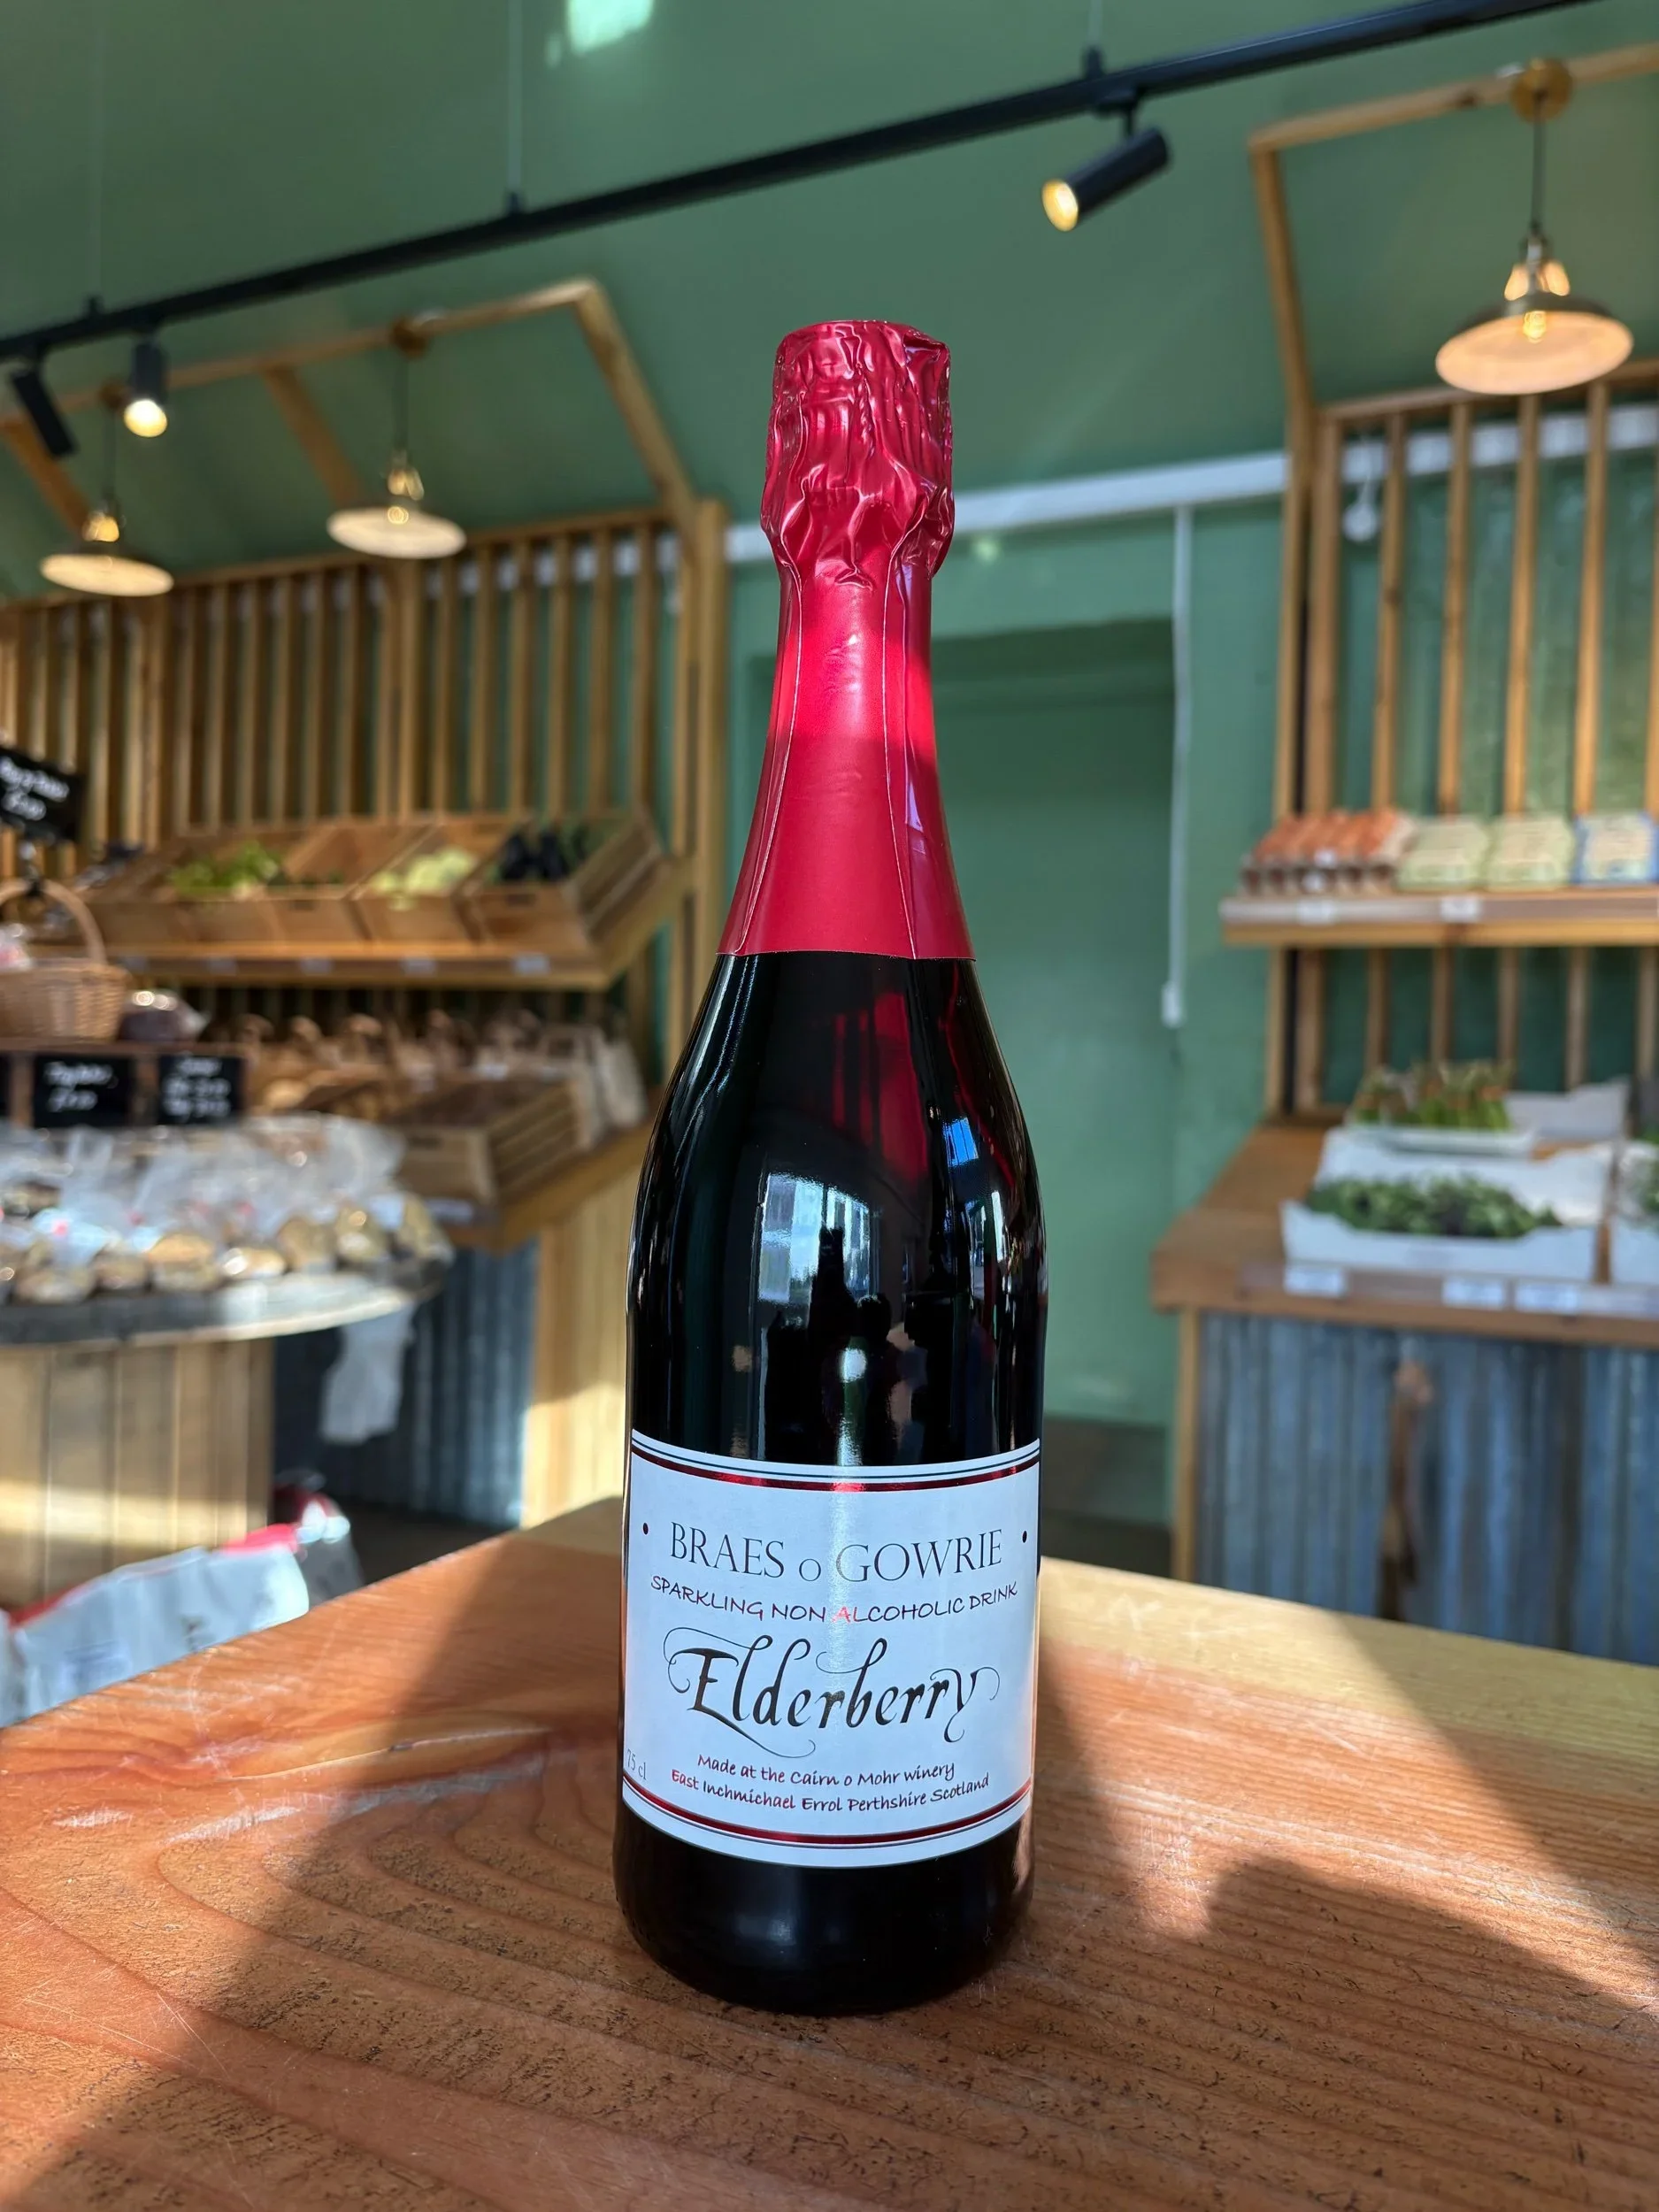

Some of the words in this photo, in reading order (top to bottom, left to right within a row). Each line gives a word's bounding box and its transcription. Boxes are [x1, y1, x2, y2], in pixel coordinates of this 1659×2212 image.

[671, 1522, 785, 1578] BRAES
[835, 1529, 1002, 1582] GOWRIE
[650, 1575, 764, 1622] SPARKLING
[772, 1602, 826, 1623] NON
[833, 1598, 964, 1623] ALCOHOLIC
[969, 1581, 1018, 1610] DRINK
[663, 1626, 1001, 1759] Elderberry
[626, 1747, 636, 1770] 75
[697, 1754, 736, 1776] Made
[740, 1765, 757, 1779] at
[761, 1766, 786, 1784] the
[789, 1770, 840, 1786] Cairn
[857, 1770, 899, 1786] Mohr
[903, 1763, 956, 1786] winery
[671, 1769, 700, 1791] East
[703, 1779, 796, 1809] Inchmichael
[801, 1796, 843, 1811] Errol
[847, 1791, 927, 1812] Perthshire
[929, 1771, 990, 1802] Scotland
